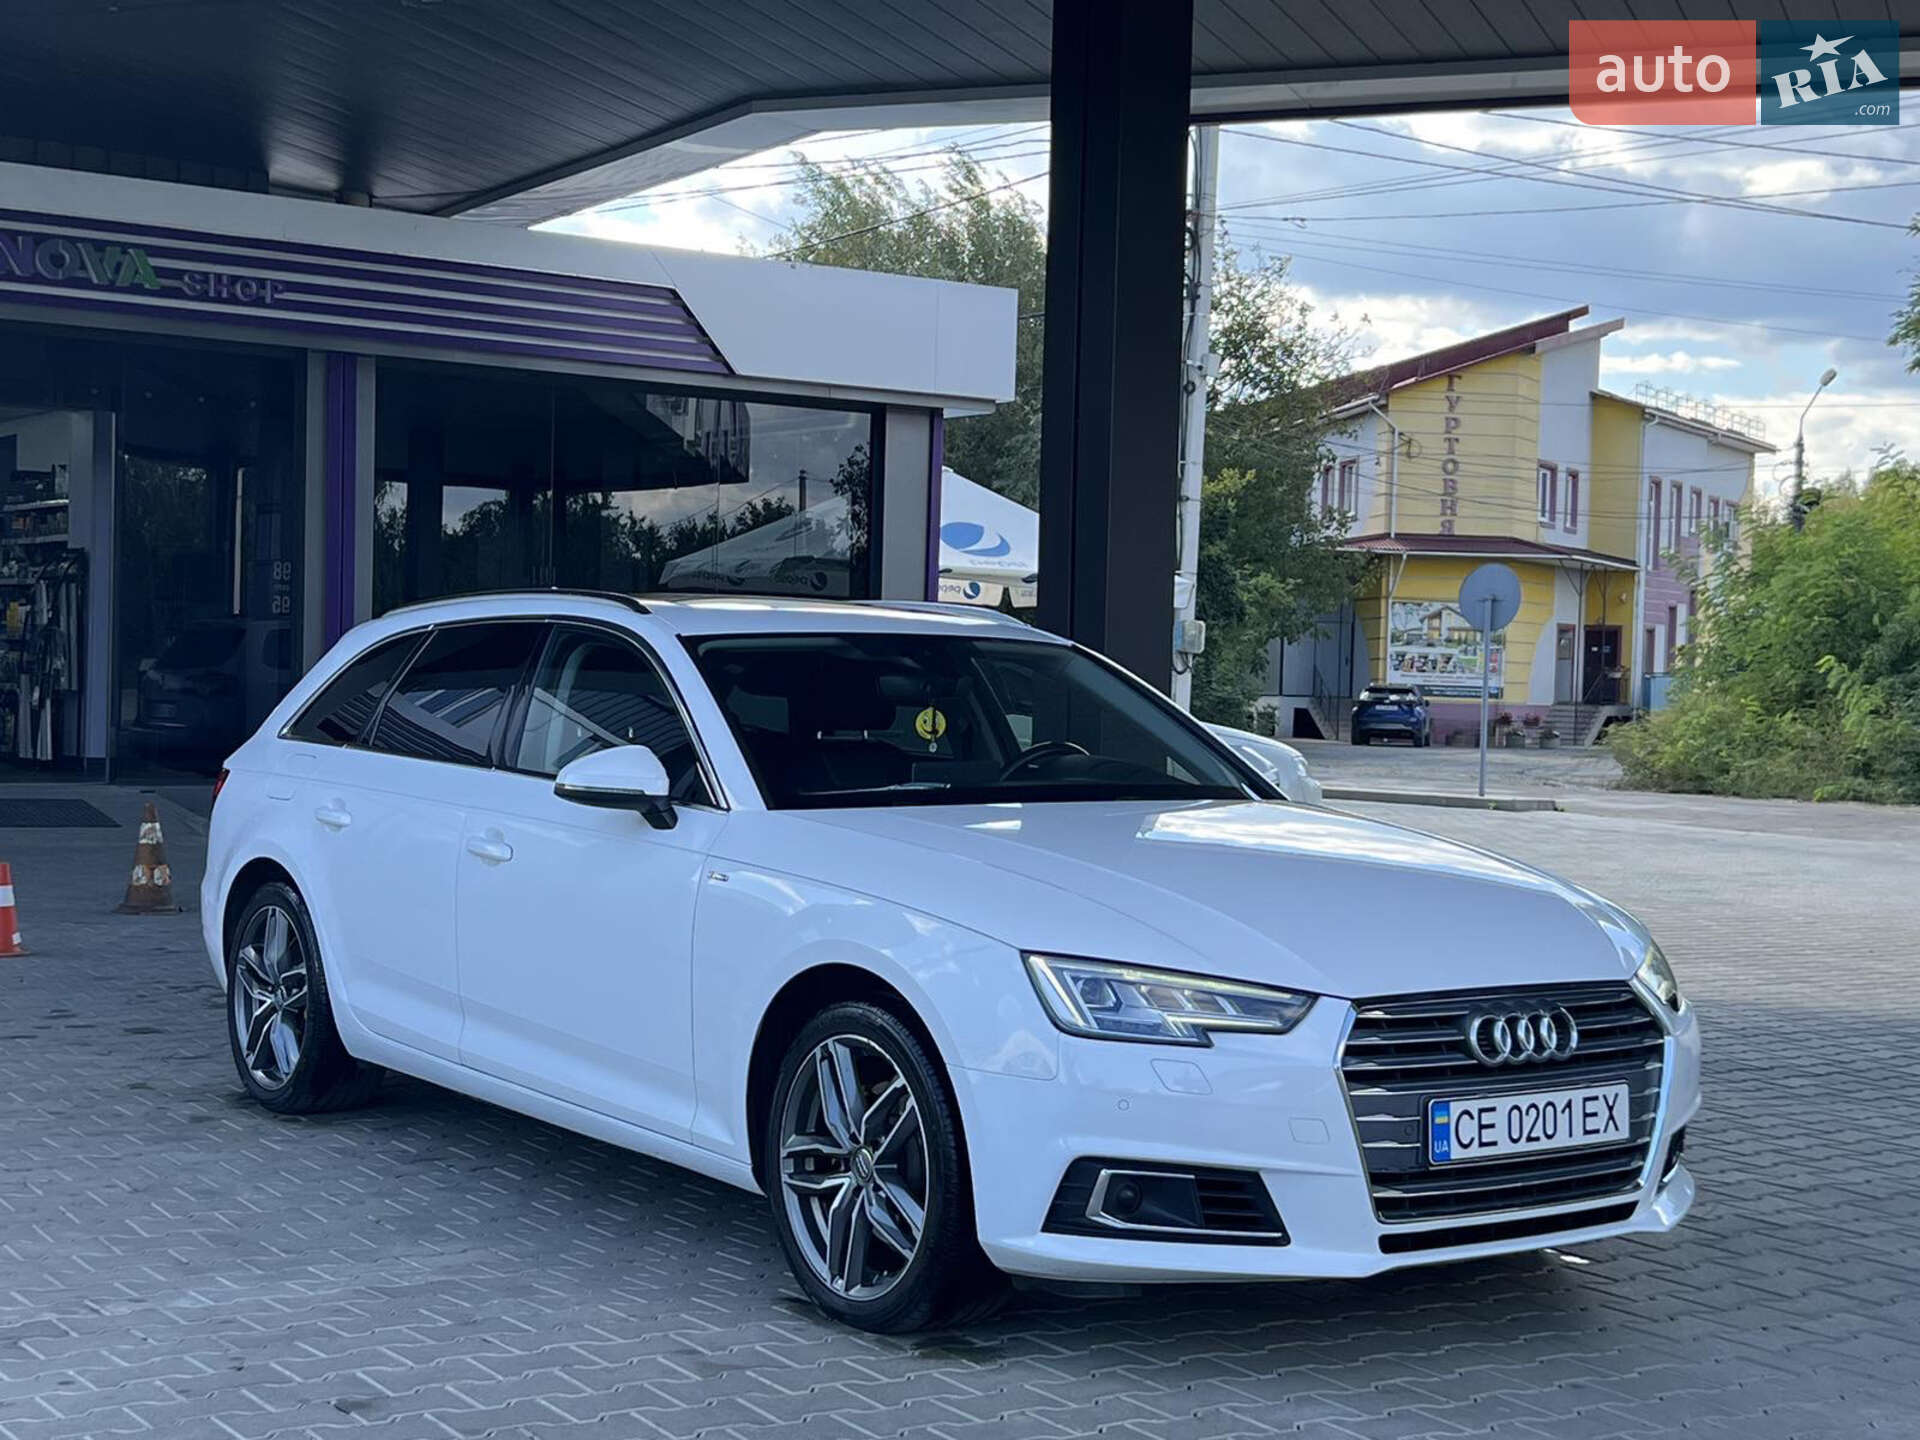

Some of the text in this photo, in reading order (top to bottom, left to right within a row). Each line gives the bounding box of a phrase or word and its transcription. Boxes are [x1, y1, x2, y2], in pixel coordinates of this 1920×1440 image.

[0, 234, 160, 290] NOVA
[1440, 374, 1463, 535] ГУРТОВНЯ
[1434, 1140, 1449, 1153] UA
[1455, 1092, 1620, 1149] CE 0201 EX
